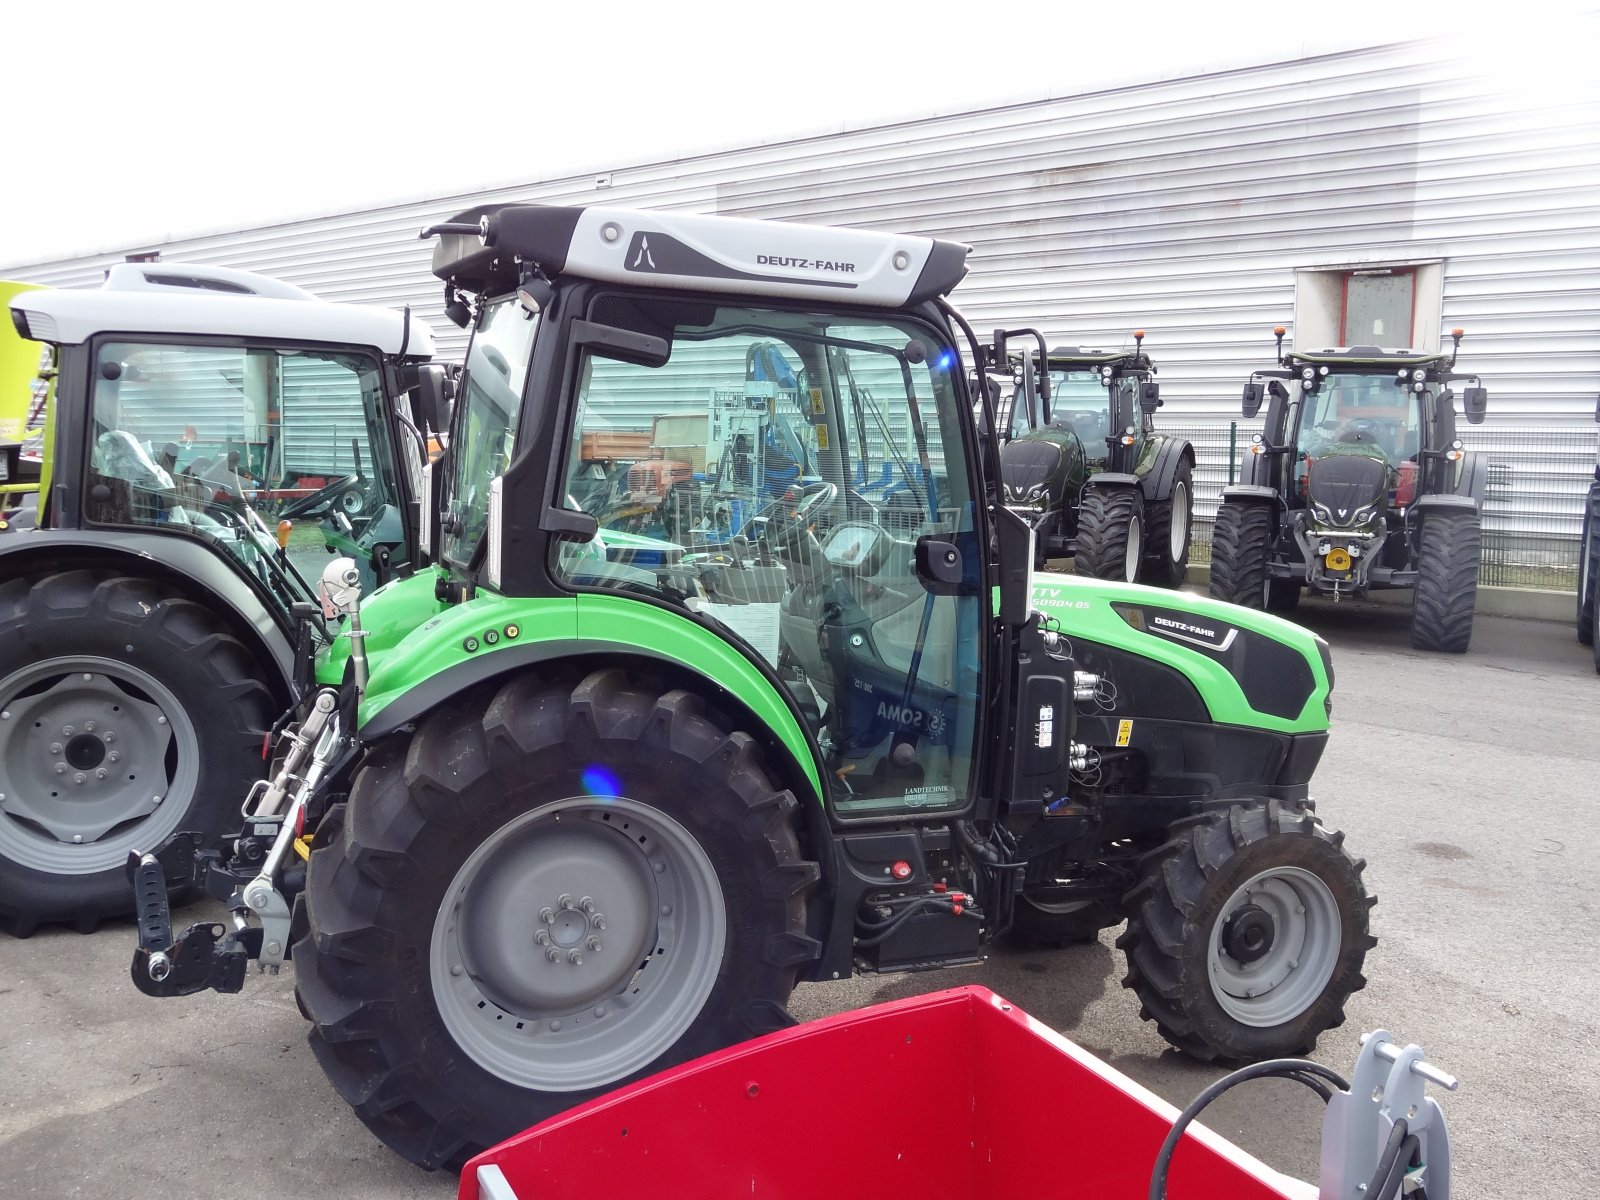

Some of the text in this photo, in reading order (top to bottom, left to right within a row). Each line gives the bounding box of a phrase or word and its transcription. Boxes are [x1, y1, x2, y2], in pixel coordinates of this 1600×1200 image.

[757, 255, 855, 272] DEUTZ-FAHR
[1154, 616, 1214, 637] DEUTZ-FAHR
[905, 785, 948, 794] LANDTECHNIK
